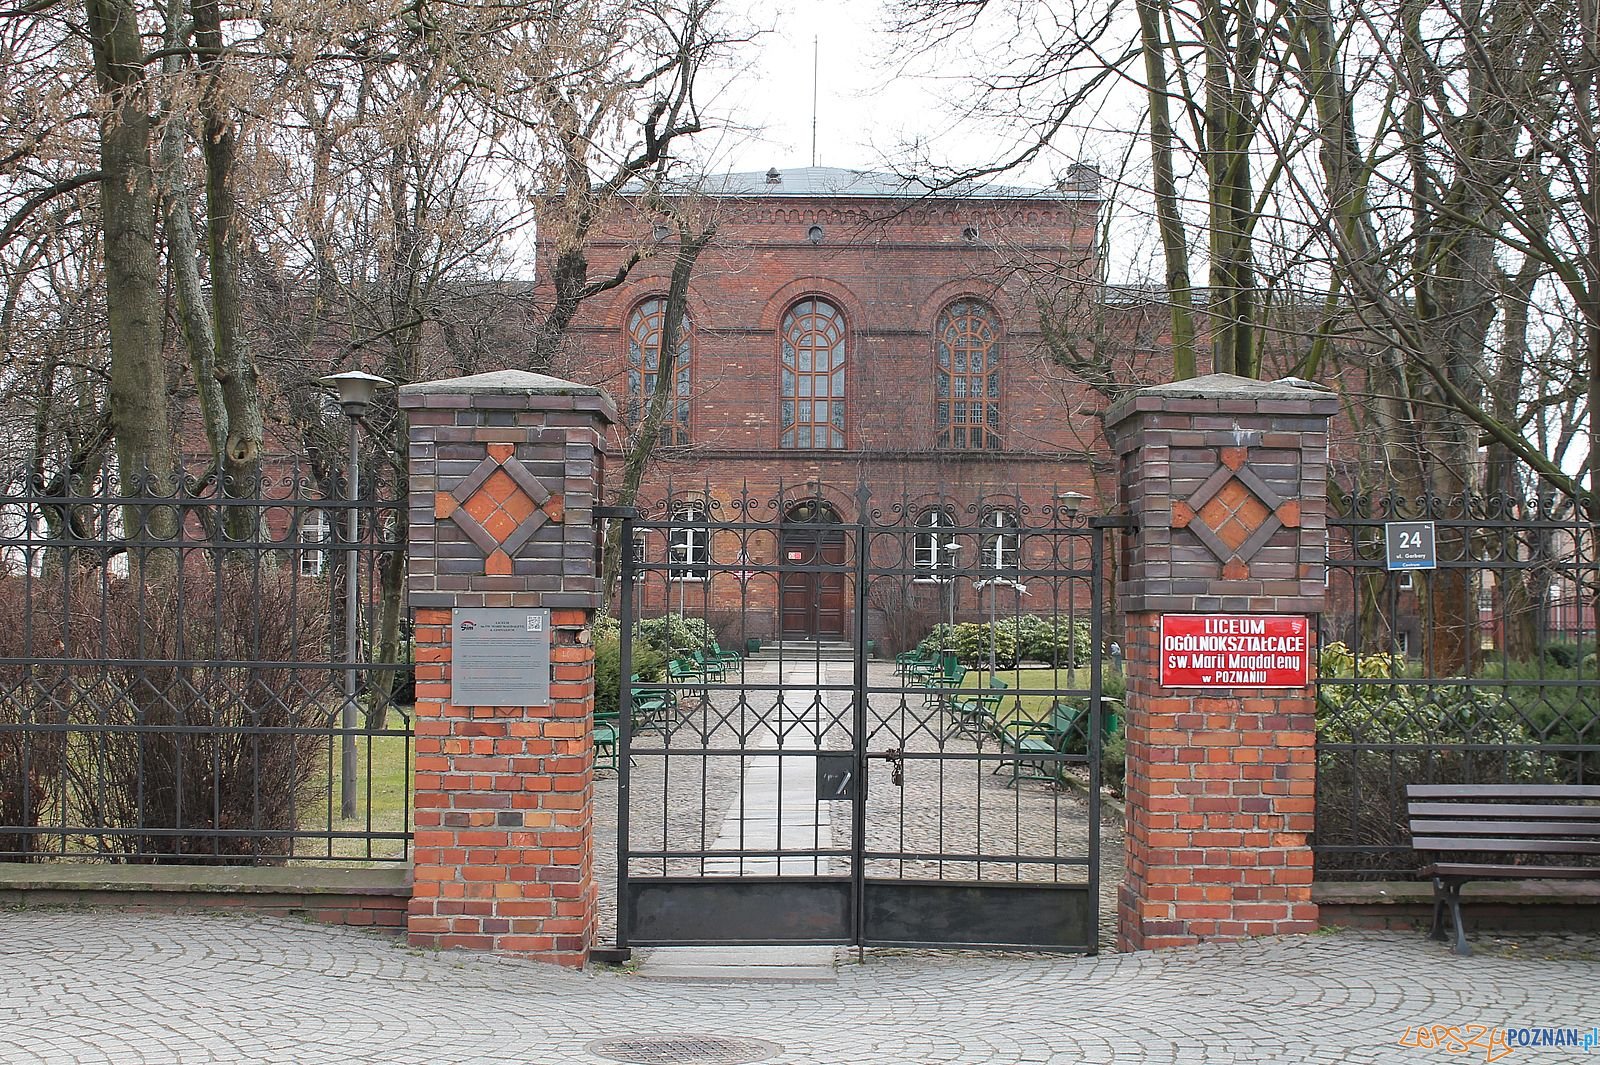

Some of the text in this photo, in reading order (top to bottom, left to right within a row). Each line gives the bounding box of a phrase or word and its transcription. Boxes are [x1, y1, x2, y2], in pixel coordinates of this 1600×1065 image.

[1399, 531, 1422, 549] 24
[1205, 618, 1265, 635] LICEUM
[1164, 633, 1305, 654] OGÓLNOKSZTAŁCĄCE
[1228, 653, 1300, 672] Magdaleny
[1201, 670, 1267, 683] w POZNANIU
